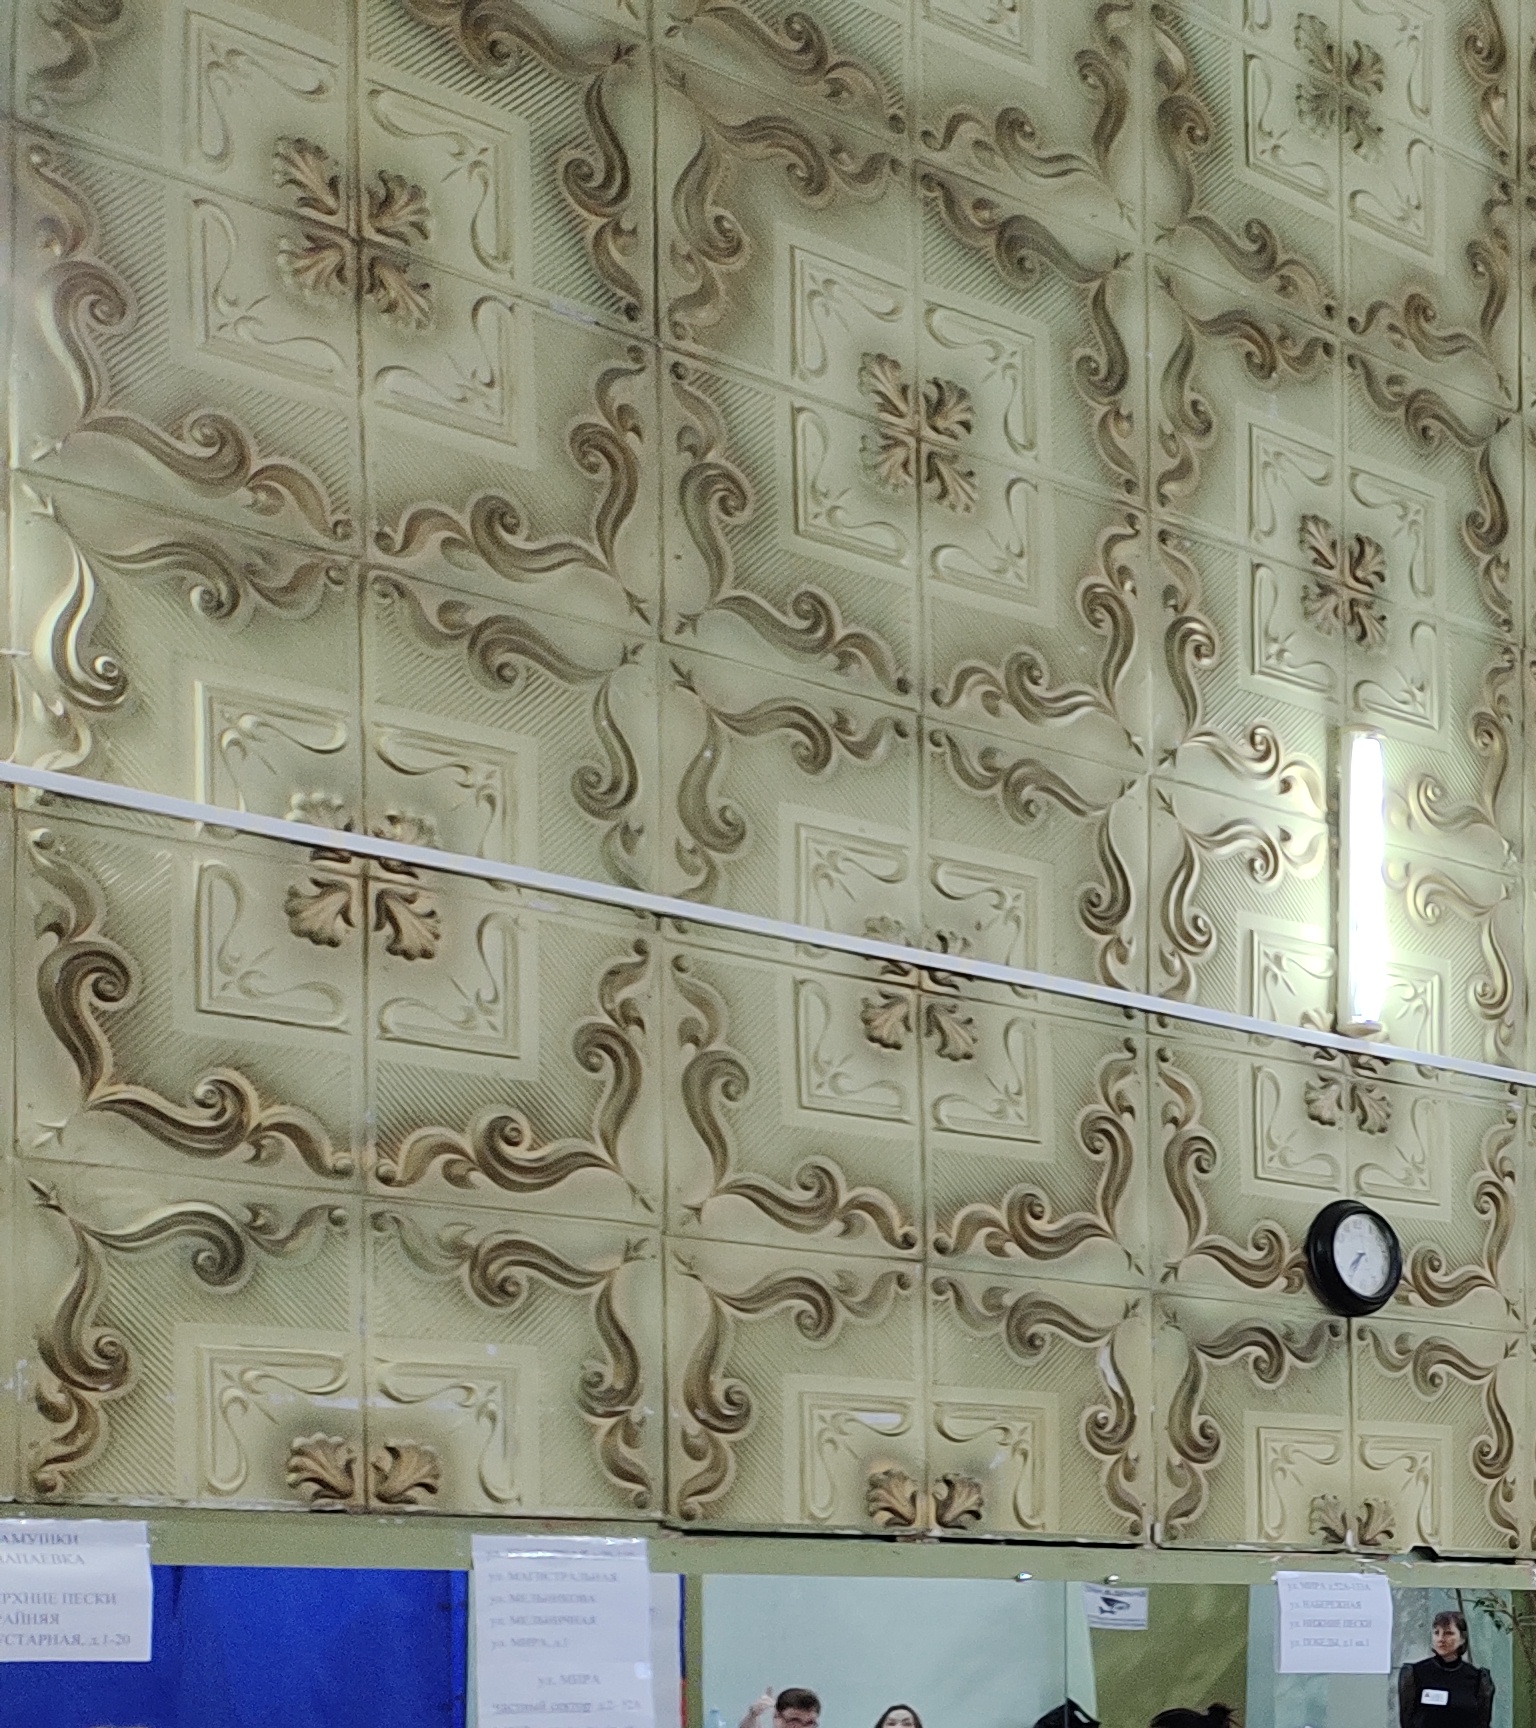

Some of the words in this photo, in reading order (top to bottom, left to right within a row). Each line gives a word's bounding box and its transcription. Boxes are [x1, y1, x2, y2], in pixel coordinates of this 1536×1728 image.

[0, 1553, 86, 1565] АПАЕВКА
[0, 1592, 57, 1605] РХНИЕ
[0, 1610, 60, 1625] АЙНЯЯ
